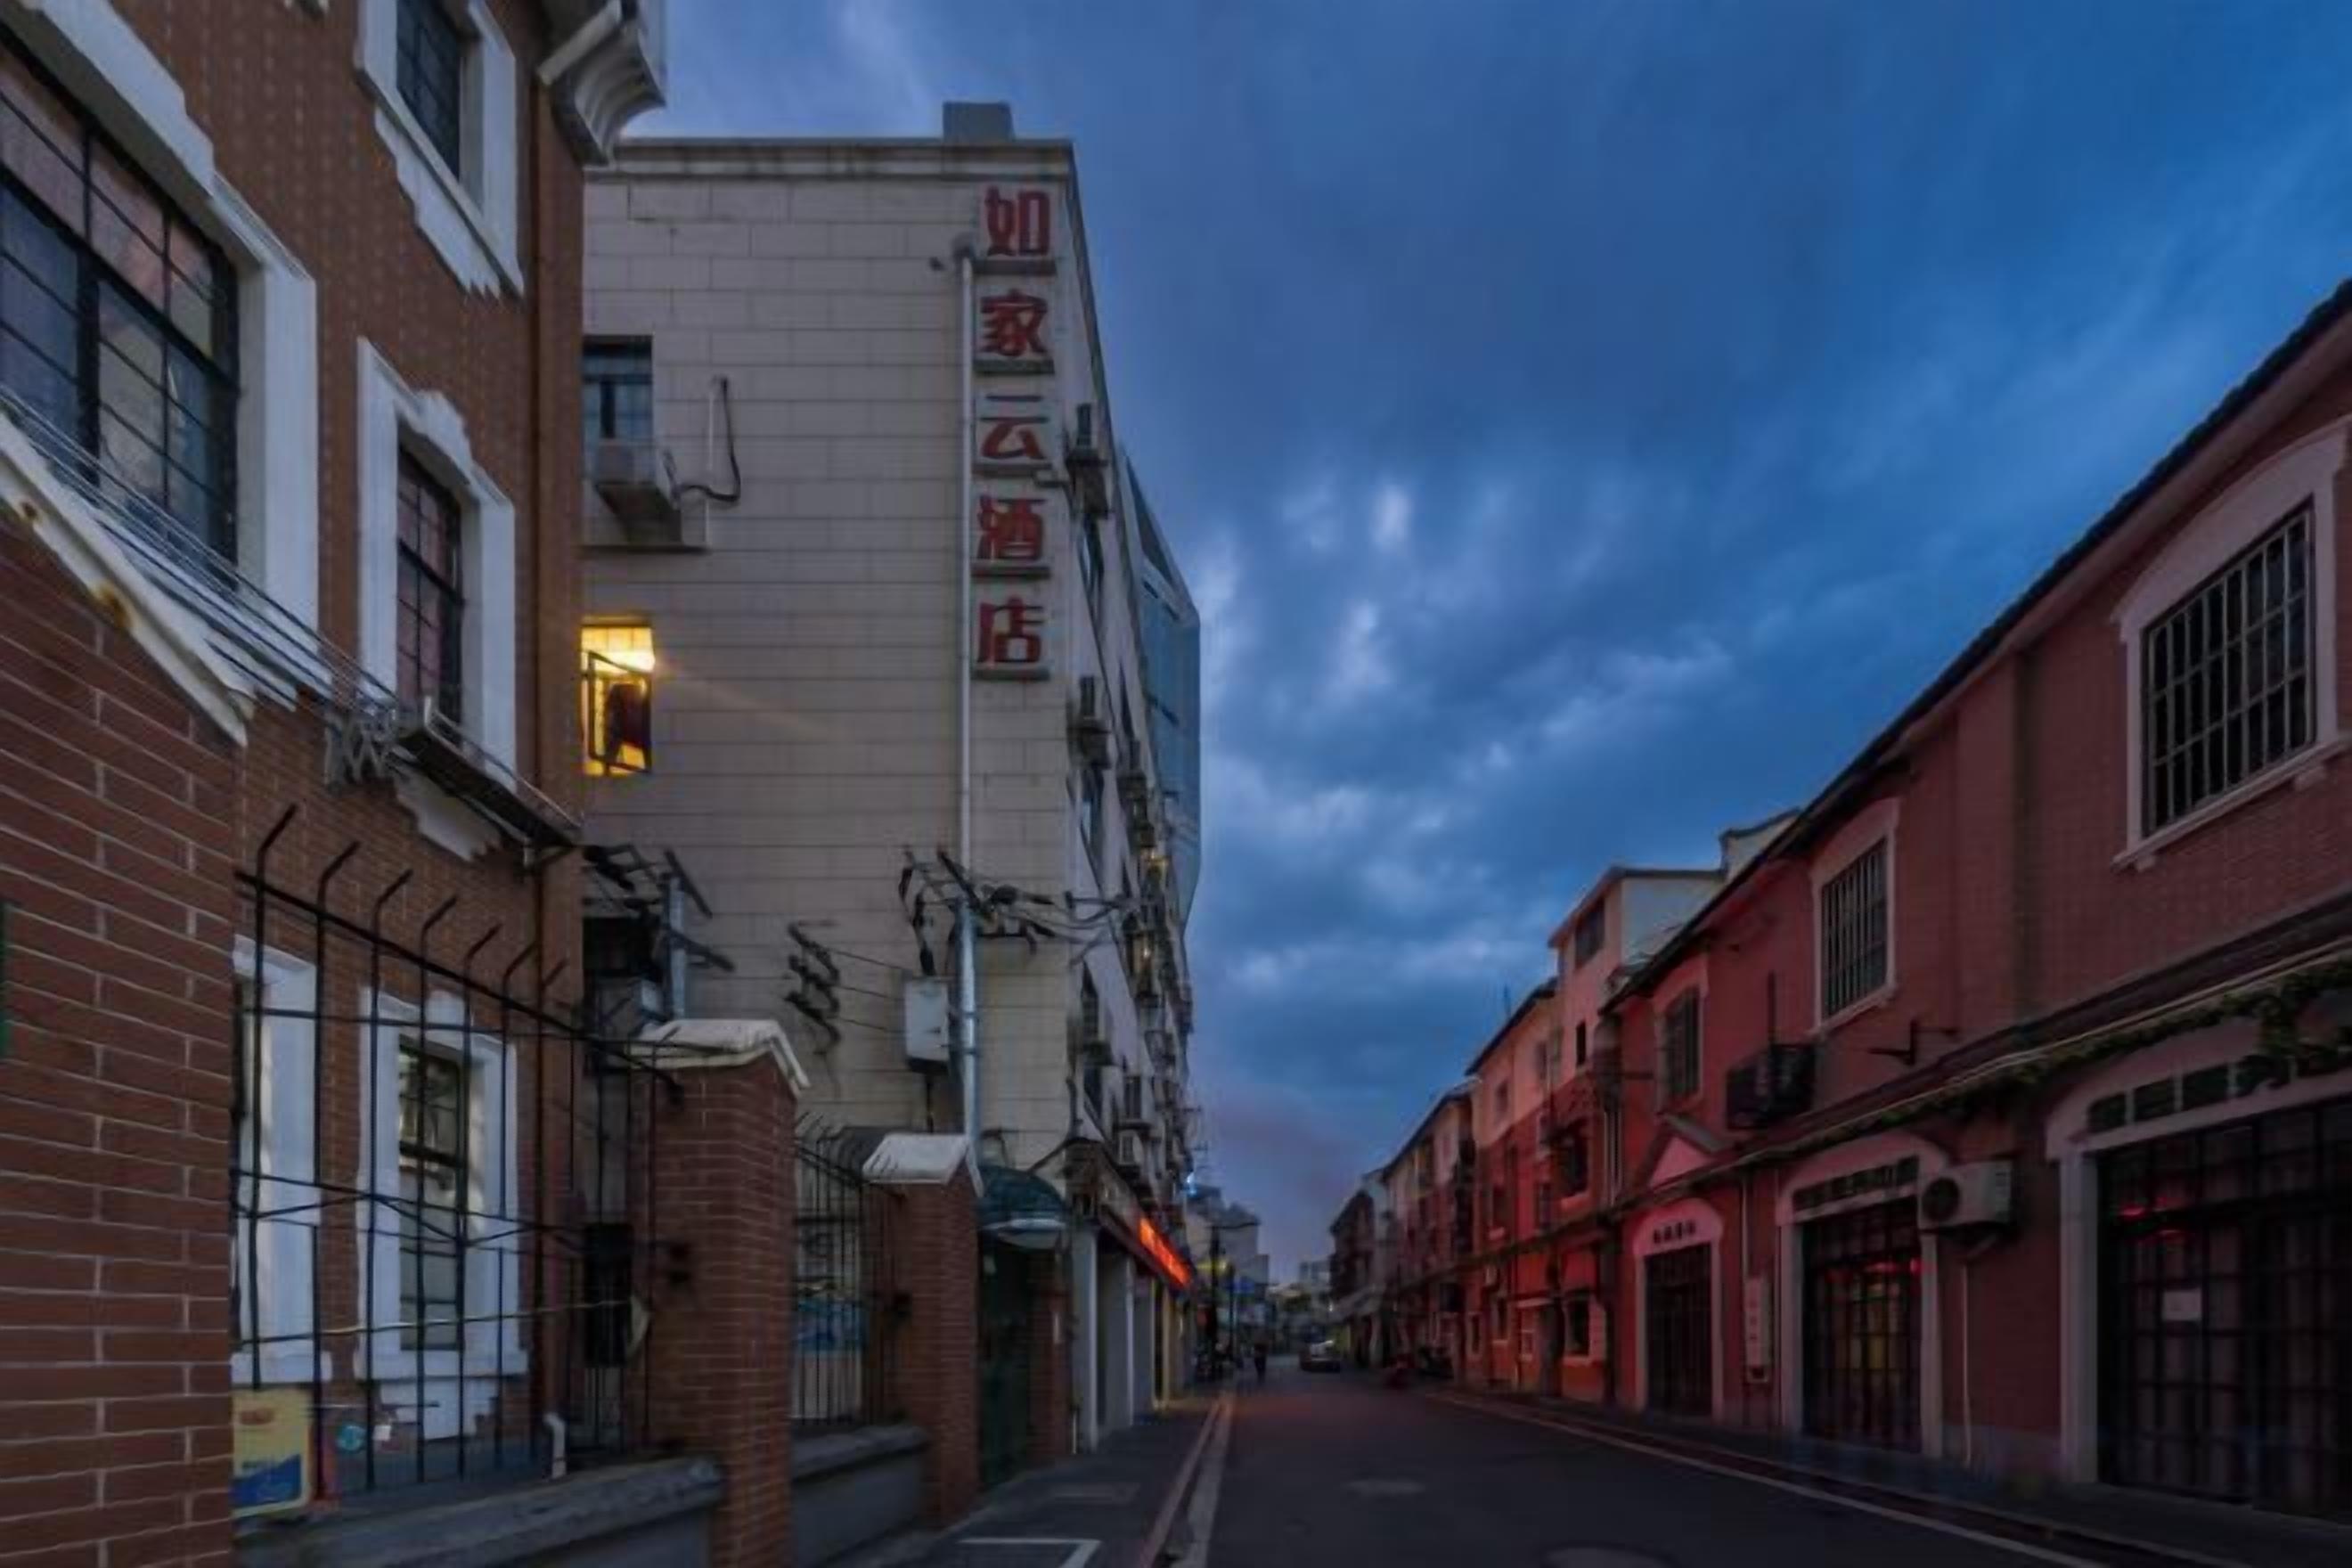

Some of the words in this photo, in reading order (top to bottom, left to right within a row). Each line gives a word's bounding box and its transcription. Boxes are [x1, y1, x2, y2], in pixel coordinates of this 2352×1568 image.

[977, 187, 1049, 665] 如家云酒店
